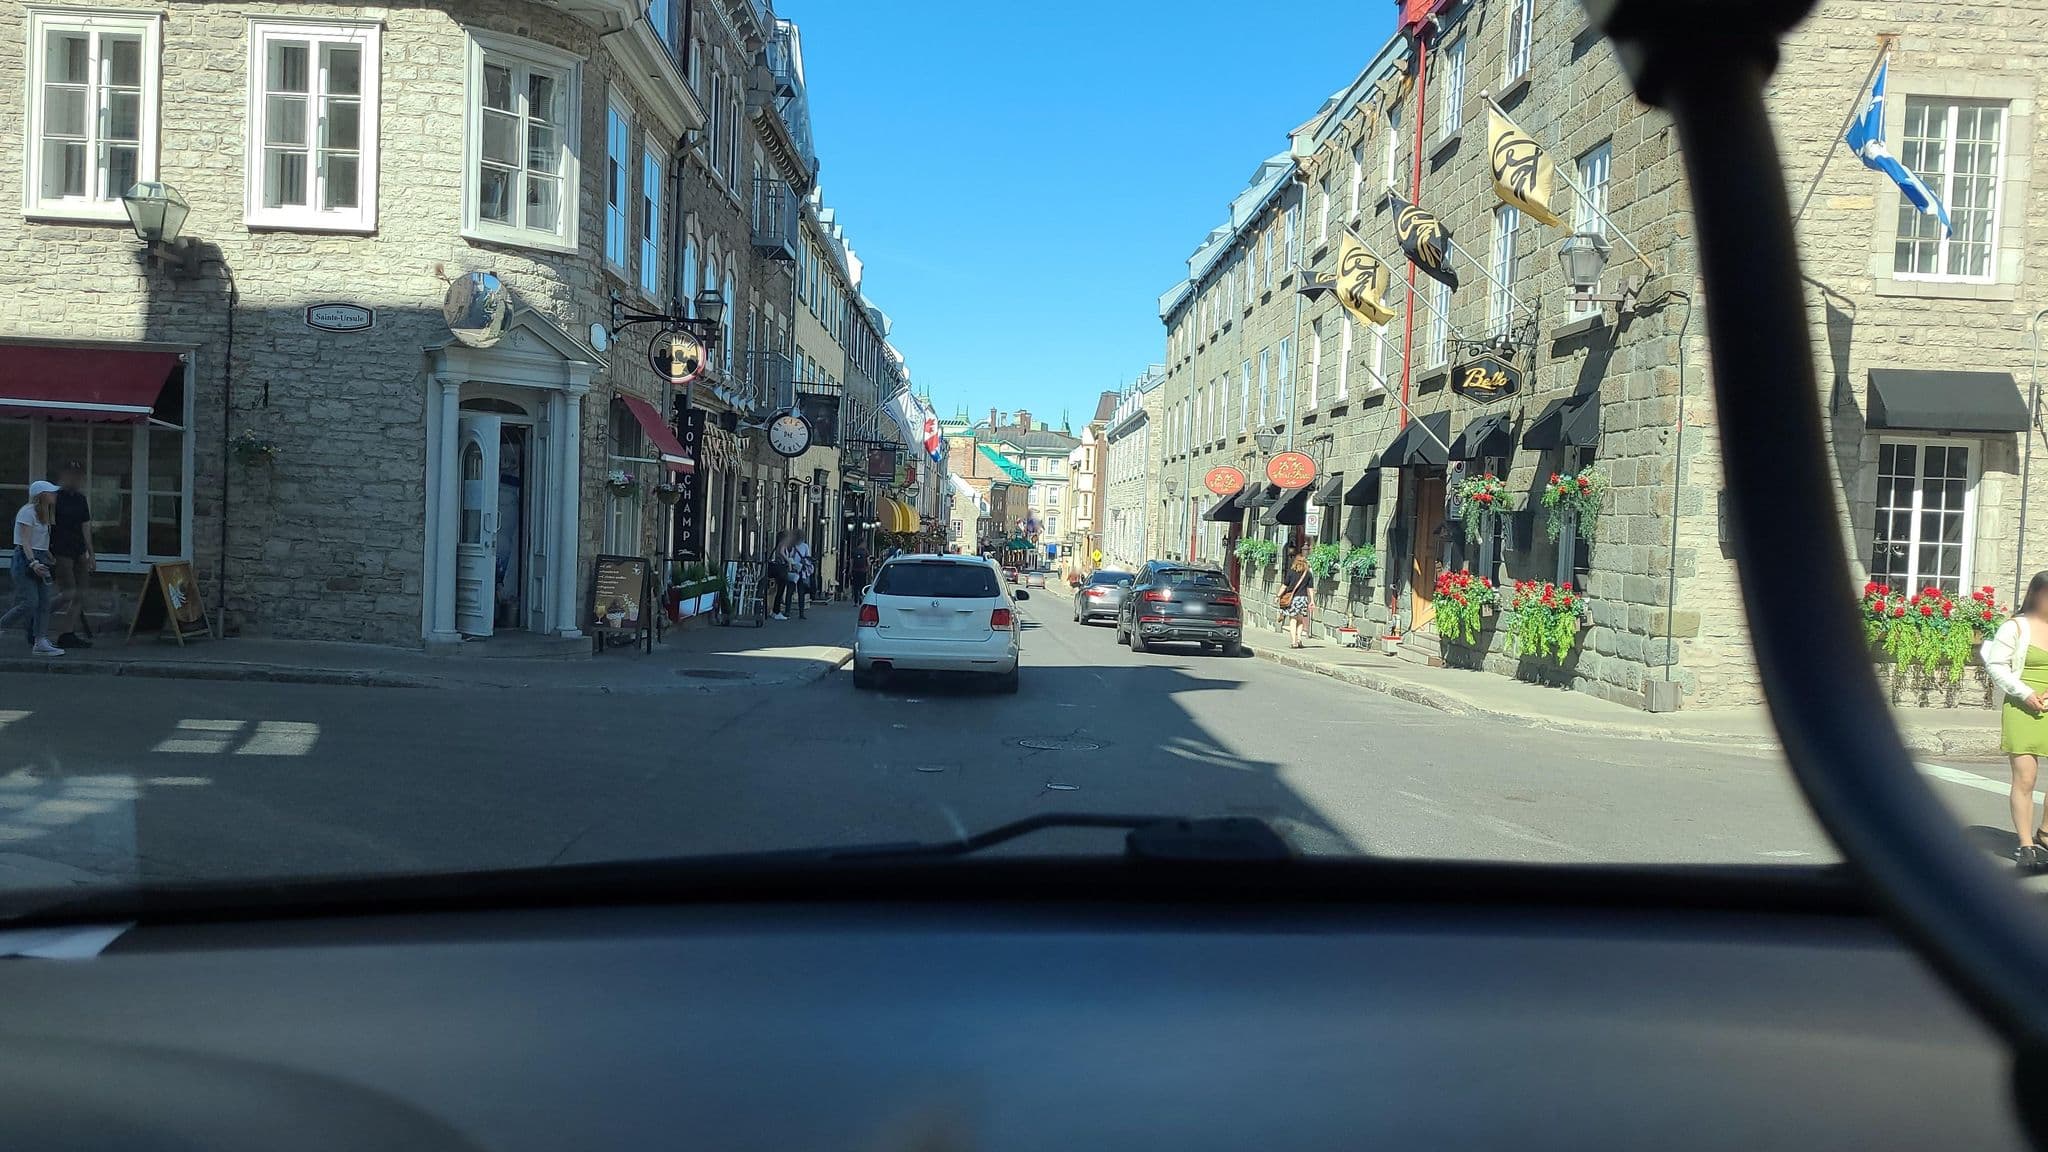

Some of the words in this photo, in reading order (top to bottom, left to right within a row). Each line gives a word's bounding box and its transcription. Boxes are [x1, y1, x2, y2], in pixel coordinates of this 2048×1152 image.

[315, 313, 364, 322] Sainte-Ursule
[1463, 367, 1507, 390] Bello
[682, 416, 694, 541] LONCHAMP
